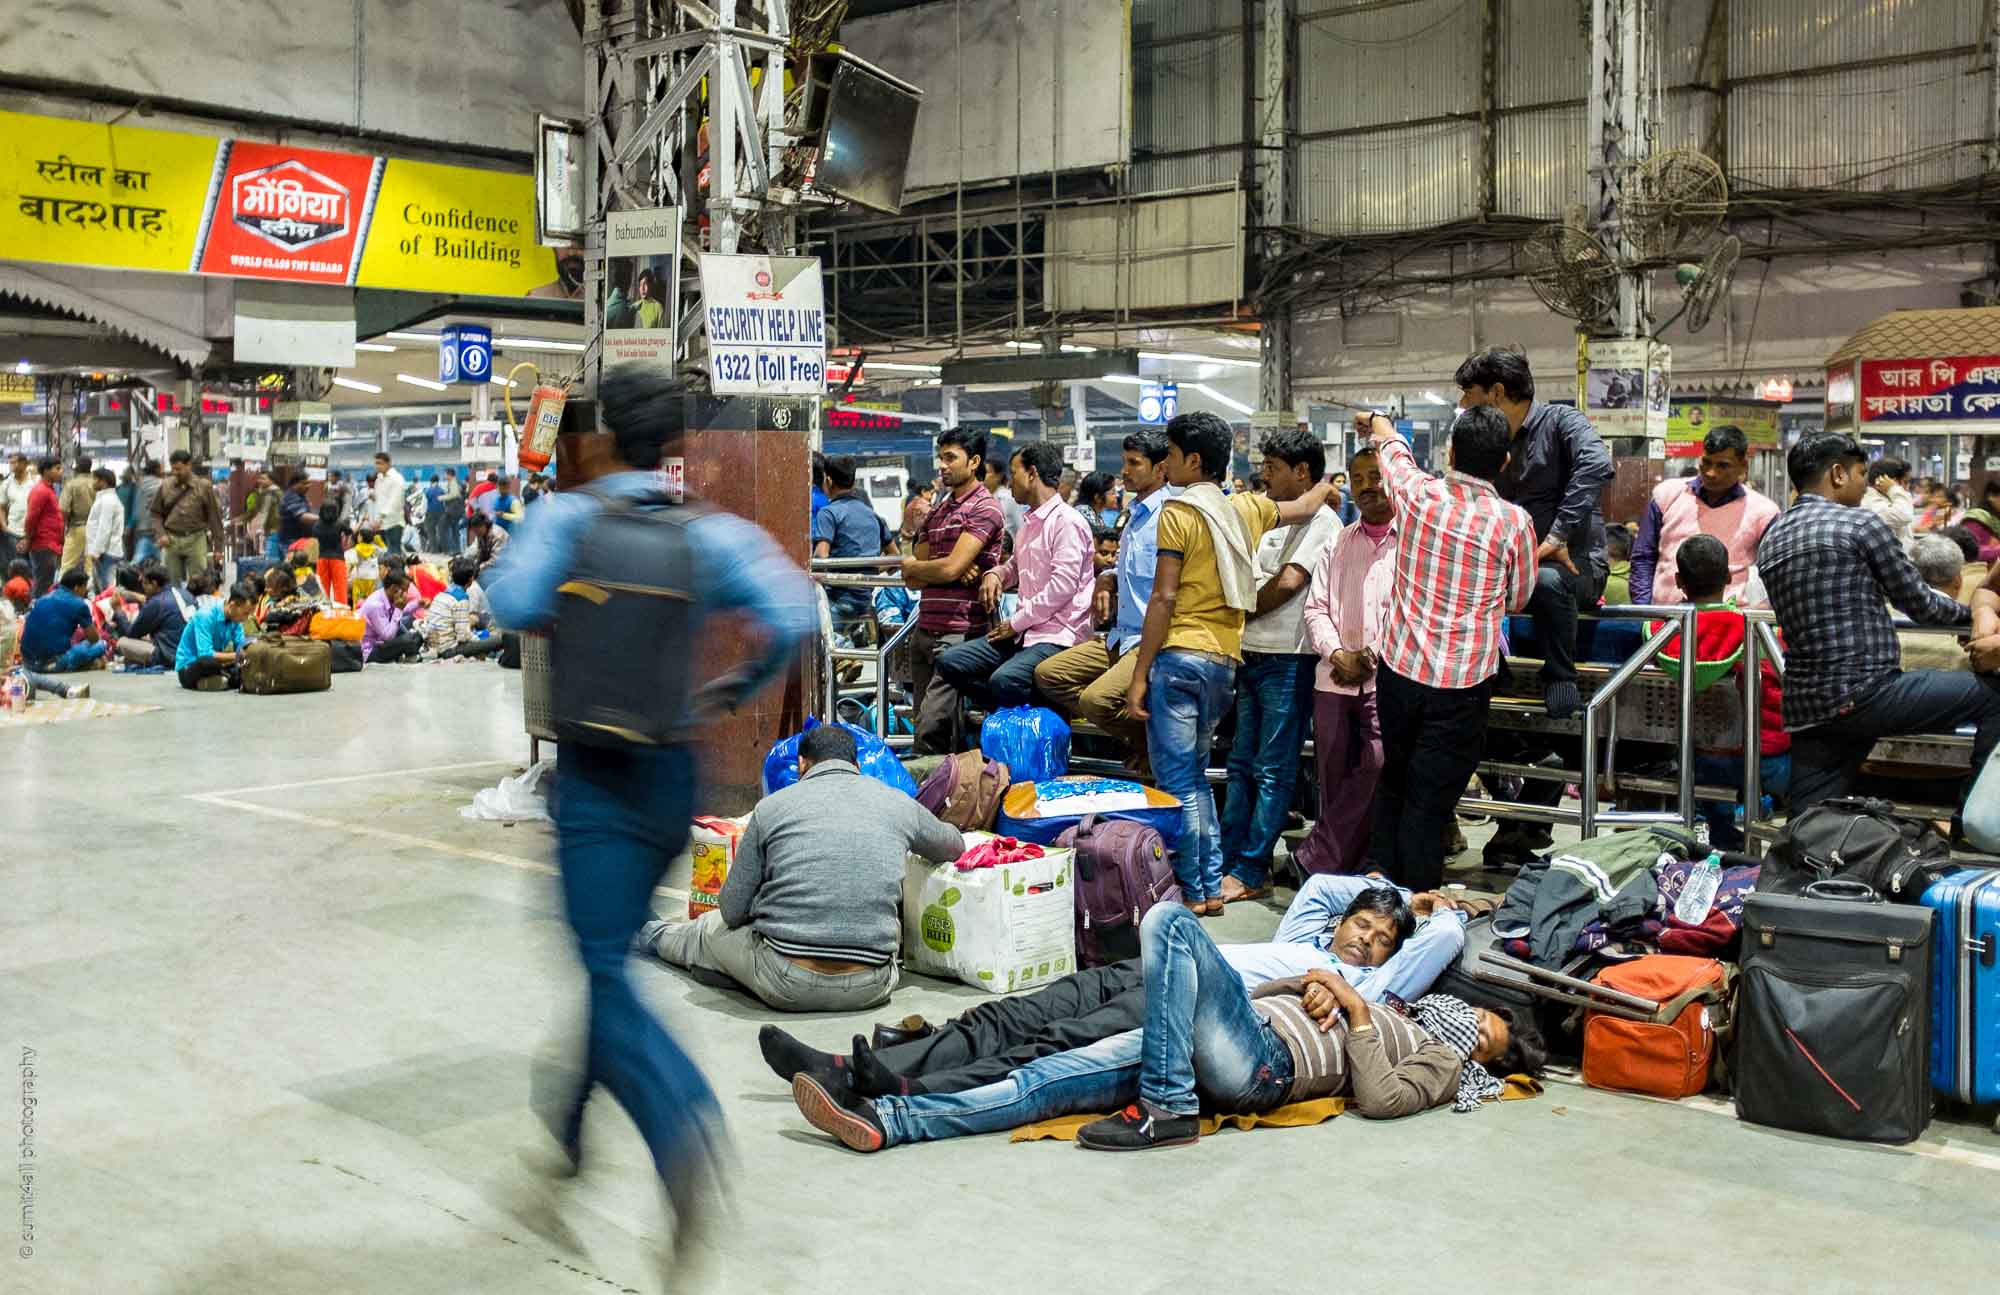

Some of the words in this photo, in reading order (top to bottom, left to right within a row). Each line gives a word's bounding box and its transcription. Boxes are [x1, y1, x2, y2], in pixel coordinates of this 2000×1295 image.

[36, 154, 105, 185] स्टील
[113, 168, 151, 190] का
[243, 177, 341, 220] मोंगिया
[19, 195, 167, 238] बादशाह
[260, 217, 320, 238] स्टील
[403, 203, 519, 234] Confidence
[230, 254, 262, 268] WORLD
[263, 257, 290, 270] CLASS
[400, 234, 422, 255] of
[434, 236, 521, 269] Building
[709, 307, 764, 341] SECURITY
[767, 308, 795, 342] HELP
[798, 308, 822, 343] LINE
[469, 350, 481, 371] 9
[715, 353, 751, 381] 1322
[755, 352, 785, 388] (Toll
[790, 352, 825, 388] Free)
[1878, 367, 1923, 387] আর
[1930, 360, 1957, 385] পি
[1865, 392, 1954, 415] সহায়তা
